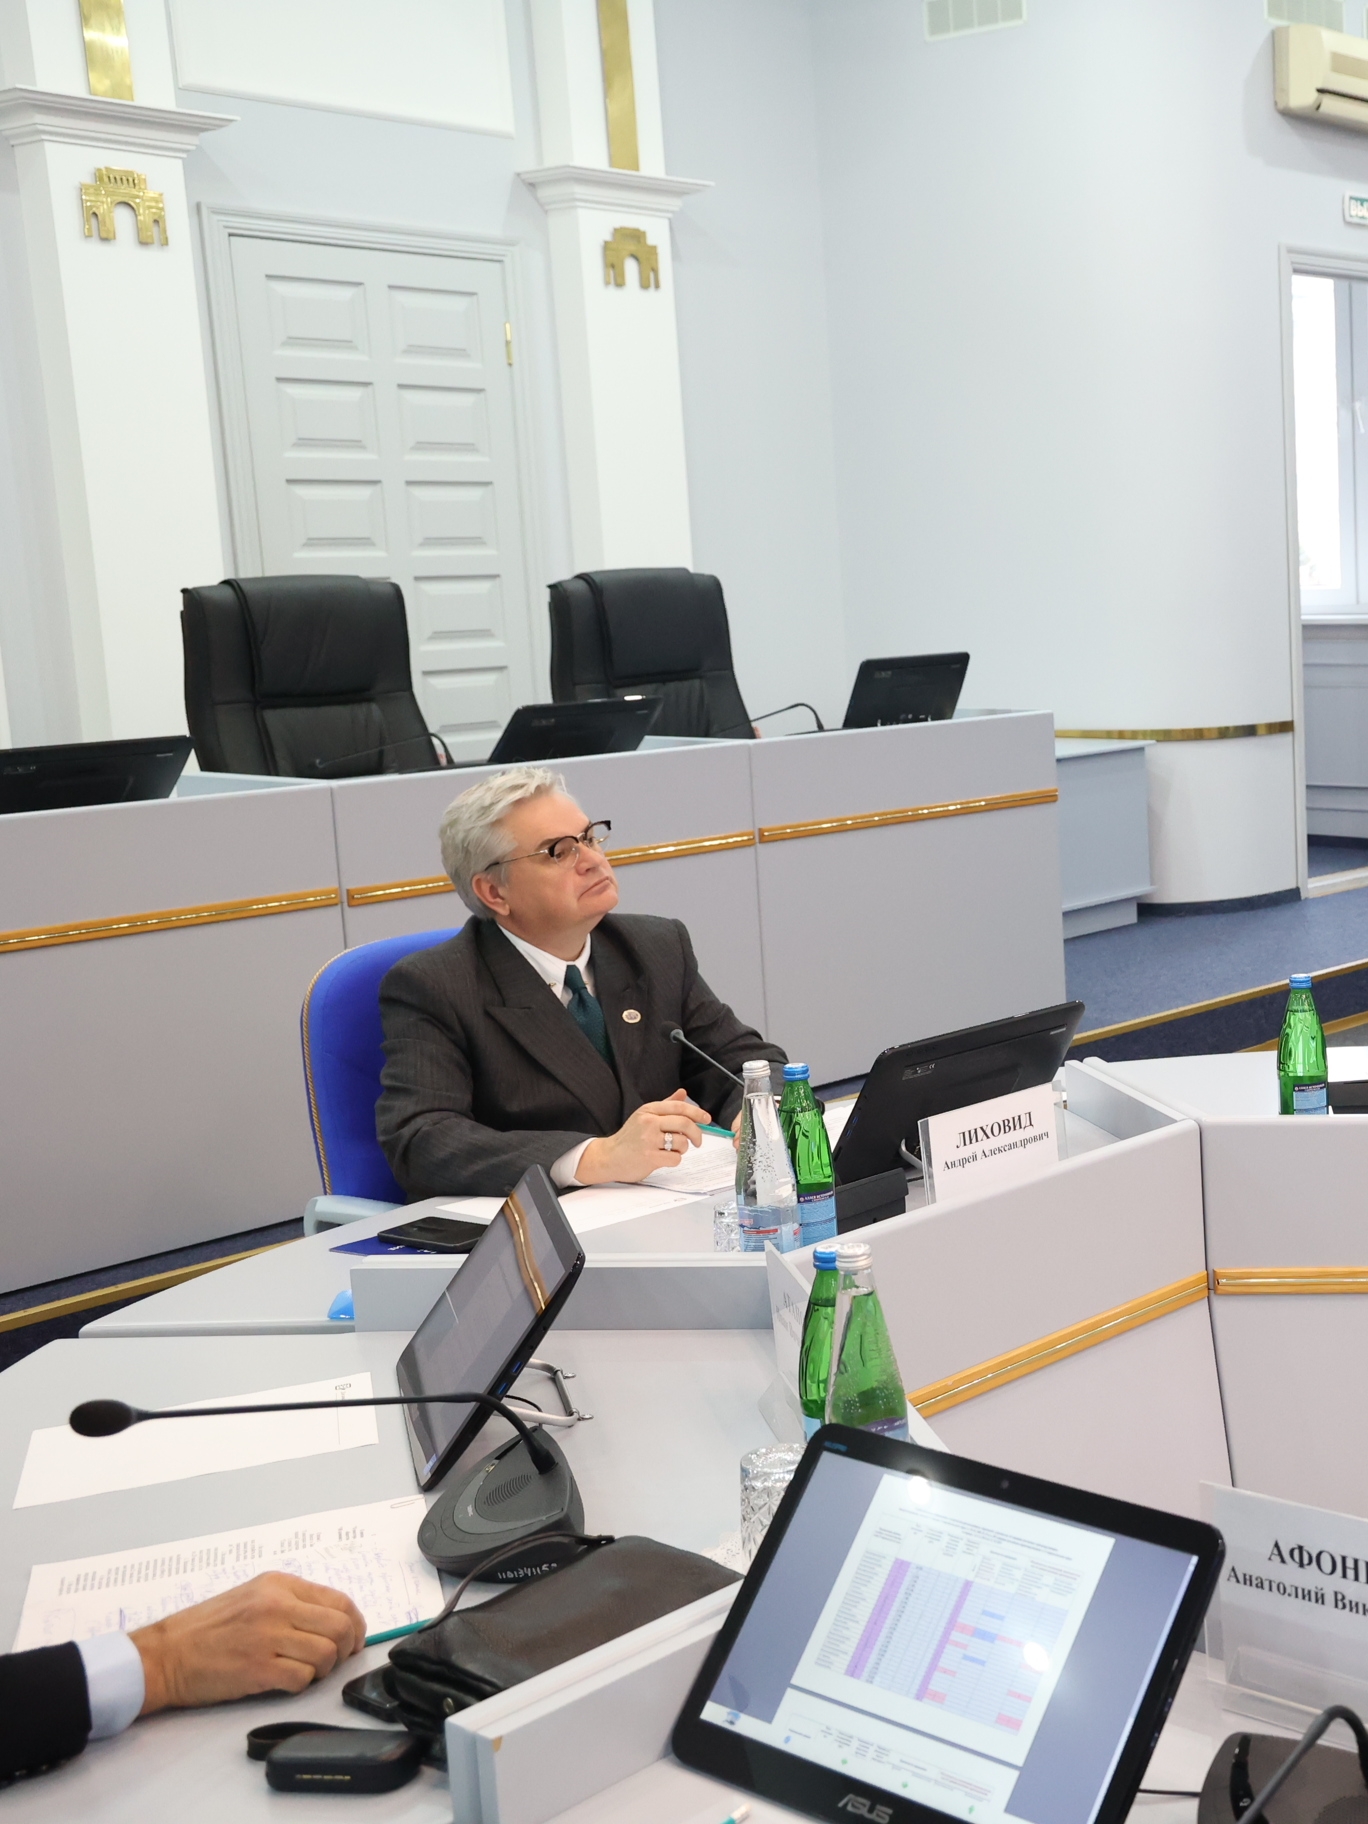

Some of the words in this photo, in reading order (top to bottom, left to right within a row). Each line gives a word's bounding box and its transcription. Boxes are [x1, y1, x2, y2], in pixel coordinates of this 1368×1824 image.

[955, 1111, 1034, 1149] ЛИХОВИД
[942, 1151, 978, 1172] Андрей
[980, 1131, 1050, 1160] Александрович
[1226, 1565, 1326, 1606] Анатолий
[837, 1793, 894, 1824] ASUS
